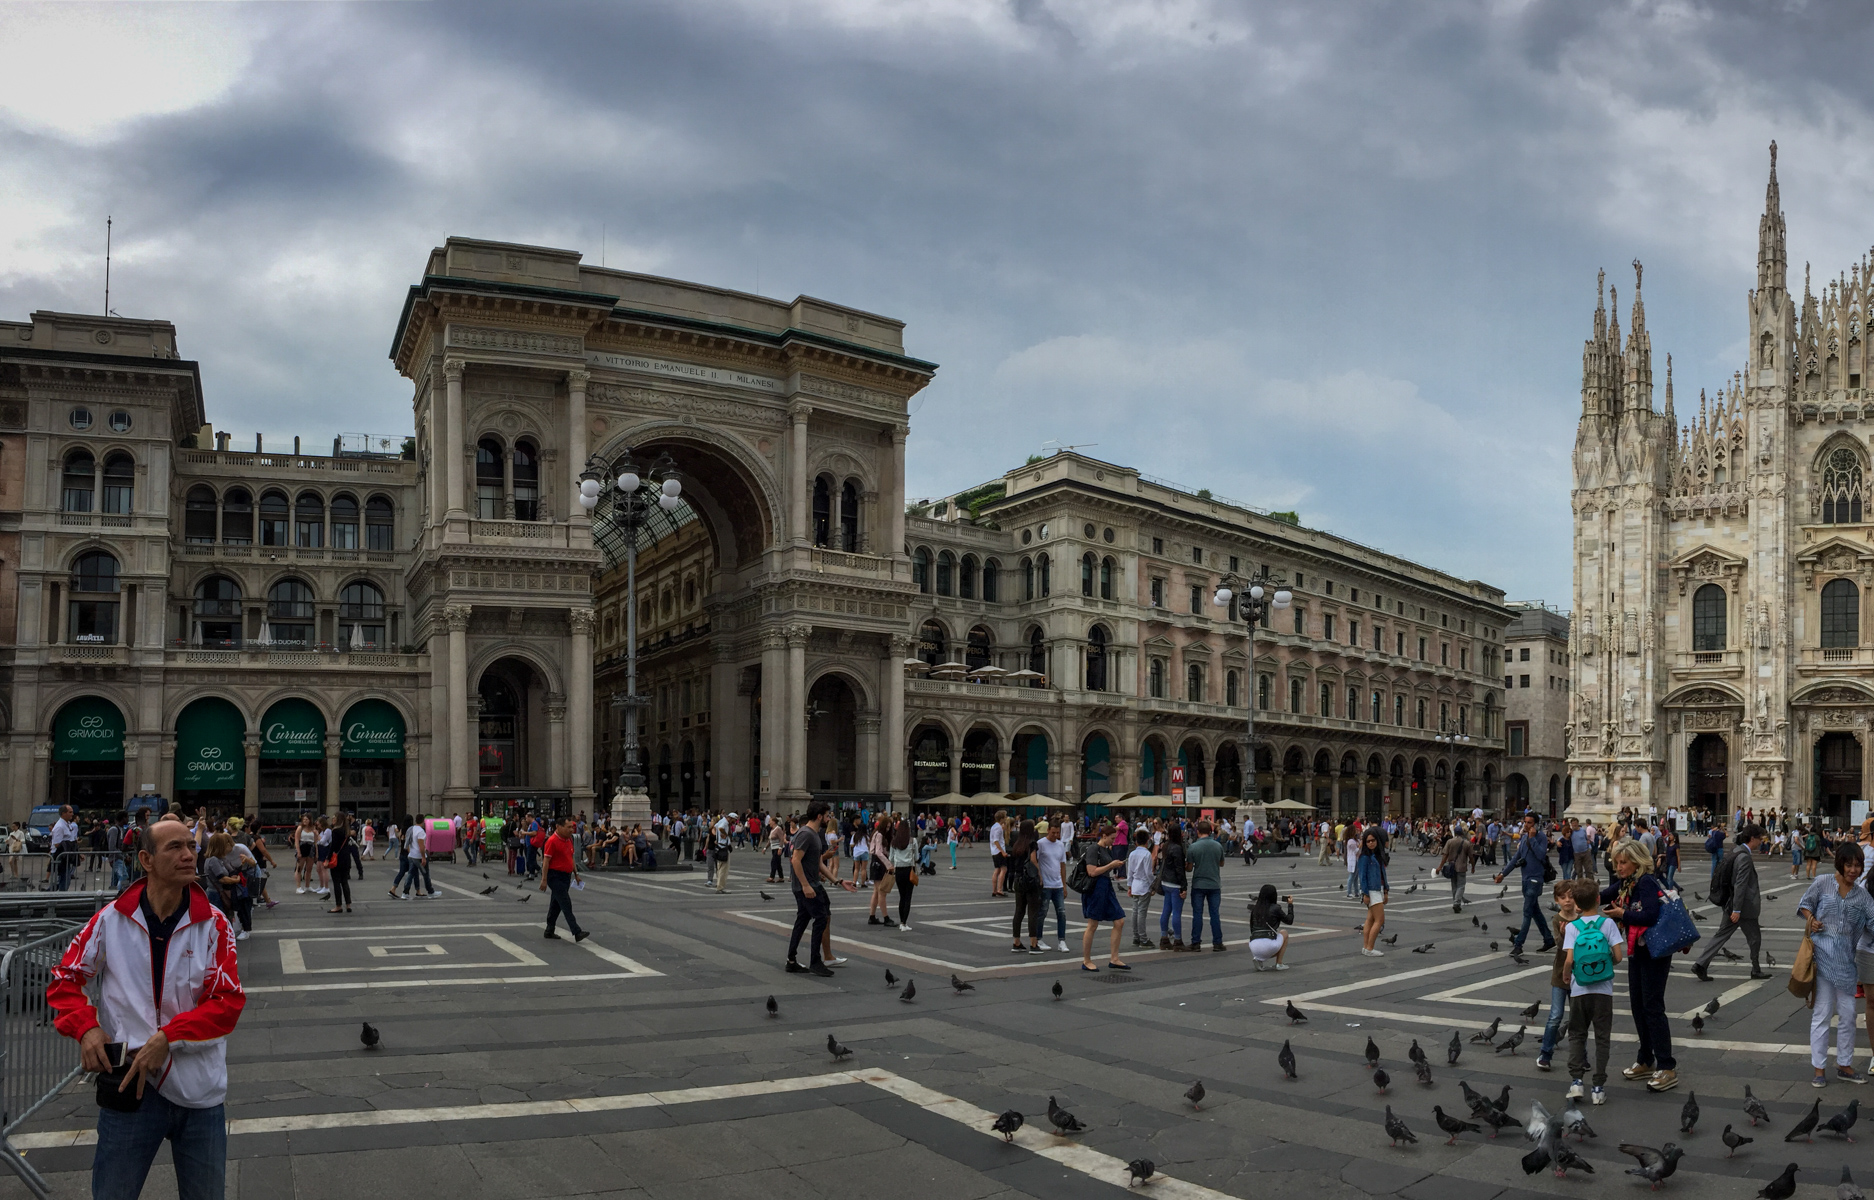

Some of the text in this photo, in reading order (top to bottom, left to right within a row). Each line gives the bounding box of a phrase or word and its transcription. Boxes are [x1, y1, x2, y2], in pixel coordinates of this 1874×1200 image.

[736, 375, 774, 388] MILANESI
[76, 633, 105, 642] LAVAZZA
[68, 729, 114, 738] GRIMOLDI
[266, 722, 318, 744] Currado
[347, 722, 397, 743] Currado
[188, 762, 233, 771] GRIMOLDI
[1172, 769, 1183, 780] M
